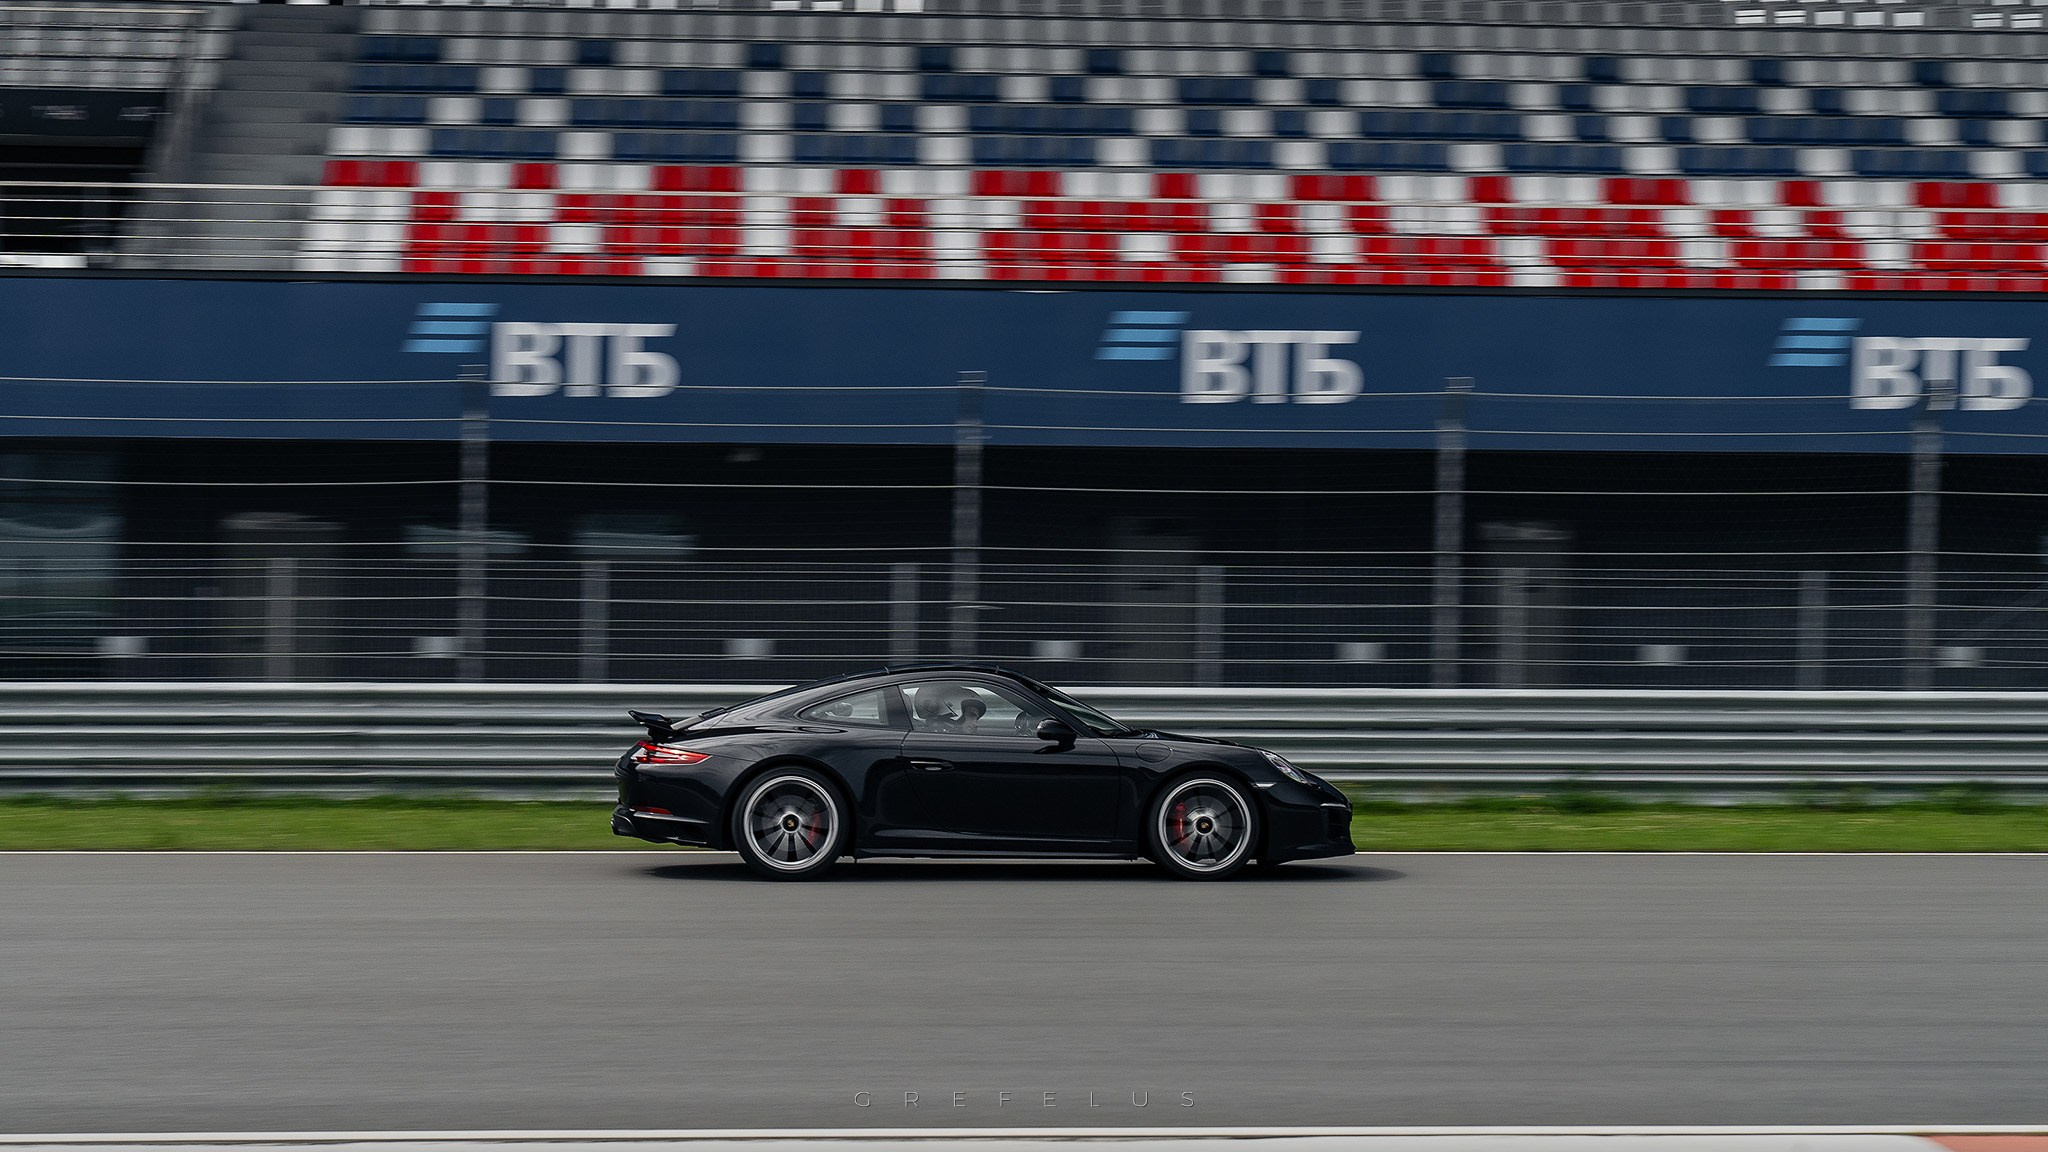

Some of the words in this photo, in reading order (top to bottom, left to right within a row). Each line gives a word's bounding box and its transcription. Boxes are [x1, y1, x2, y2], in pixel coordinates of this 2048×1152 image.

[489, 322, 681, 398] ВТБ
[1180, 330, 1365, 404] ВТБ
[1850, 336, 2034, 411] ВТБ
